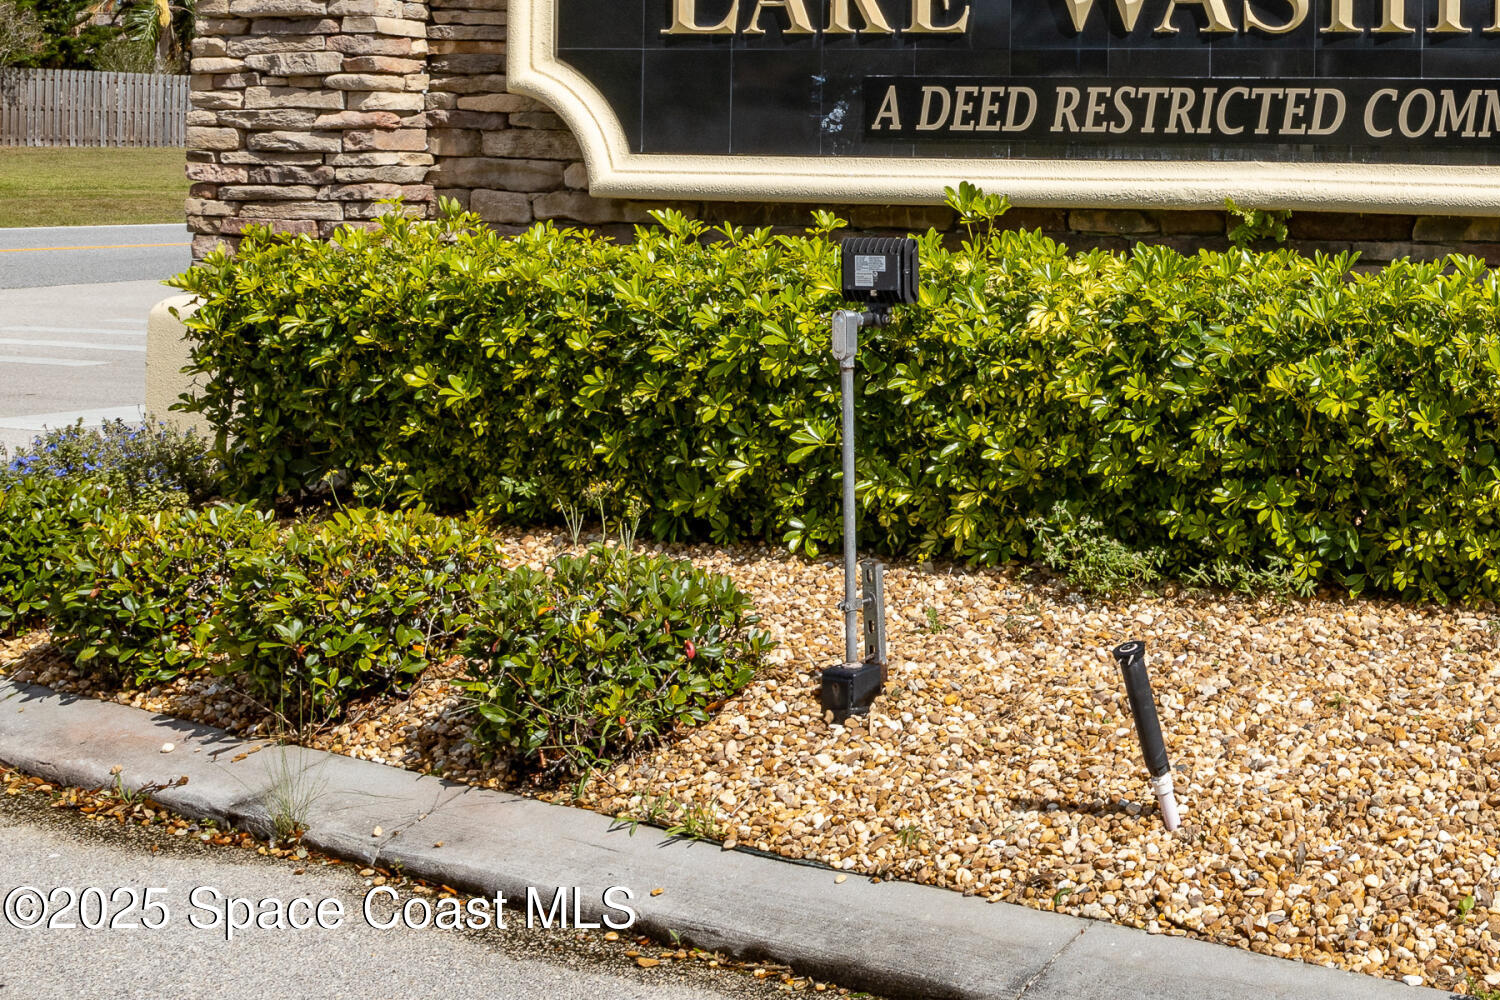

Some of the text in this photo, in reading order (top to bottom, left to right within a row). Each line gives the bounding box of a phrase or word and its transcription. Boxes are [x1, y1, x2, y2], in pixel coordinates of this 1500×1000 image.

[871, 85, 901, 131] A
[915, 85, 1038, 132] DEED
[1050, 86, 1346, 136] RESTRICTED
